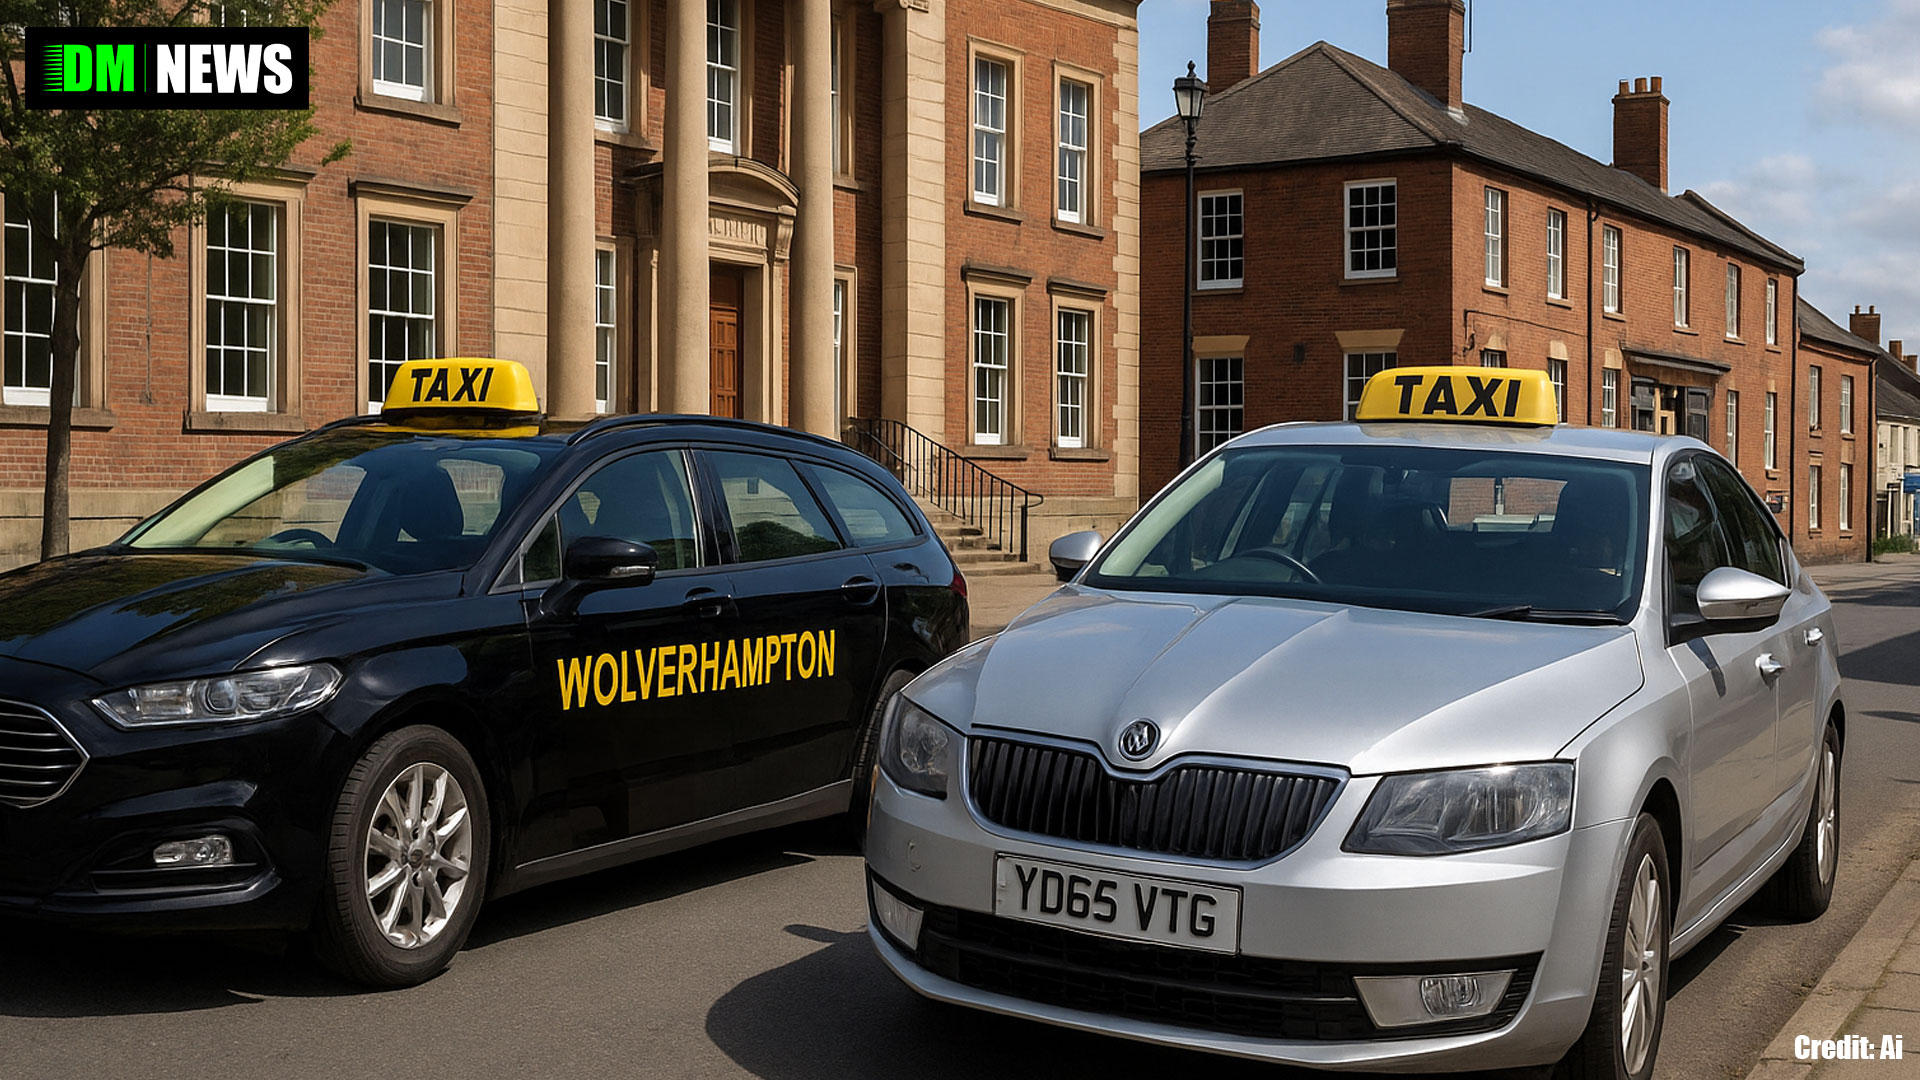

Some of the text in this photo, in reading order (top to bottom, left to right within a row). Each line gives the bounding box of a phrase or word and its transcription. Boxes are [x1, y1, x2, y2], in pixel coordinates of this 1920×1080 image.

[411, 367, 494, 402] TAXI
[1394, 375, 1522, 418] TAXI
[556, 629, 836, 710] WOLVERHAMPTON
[1015, 864, 1217, 937] YD65 VTG
